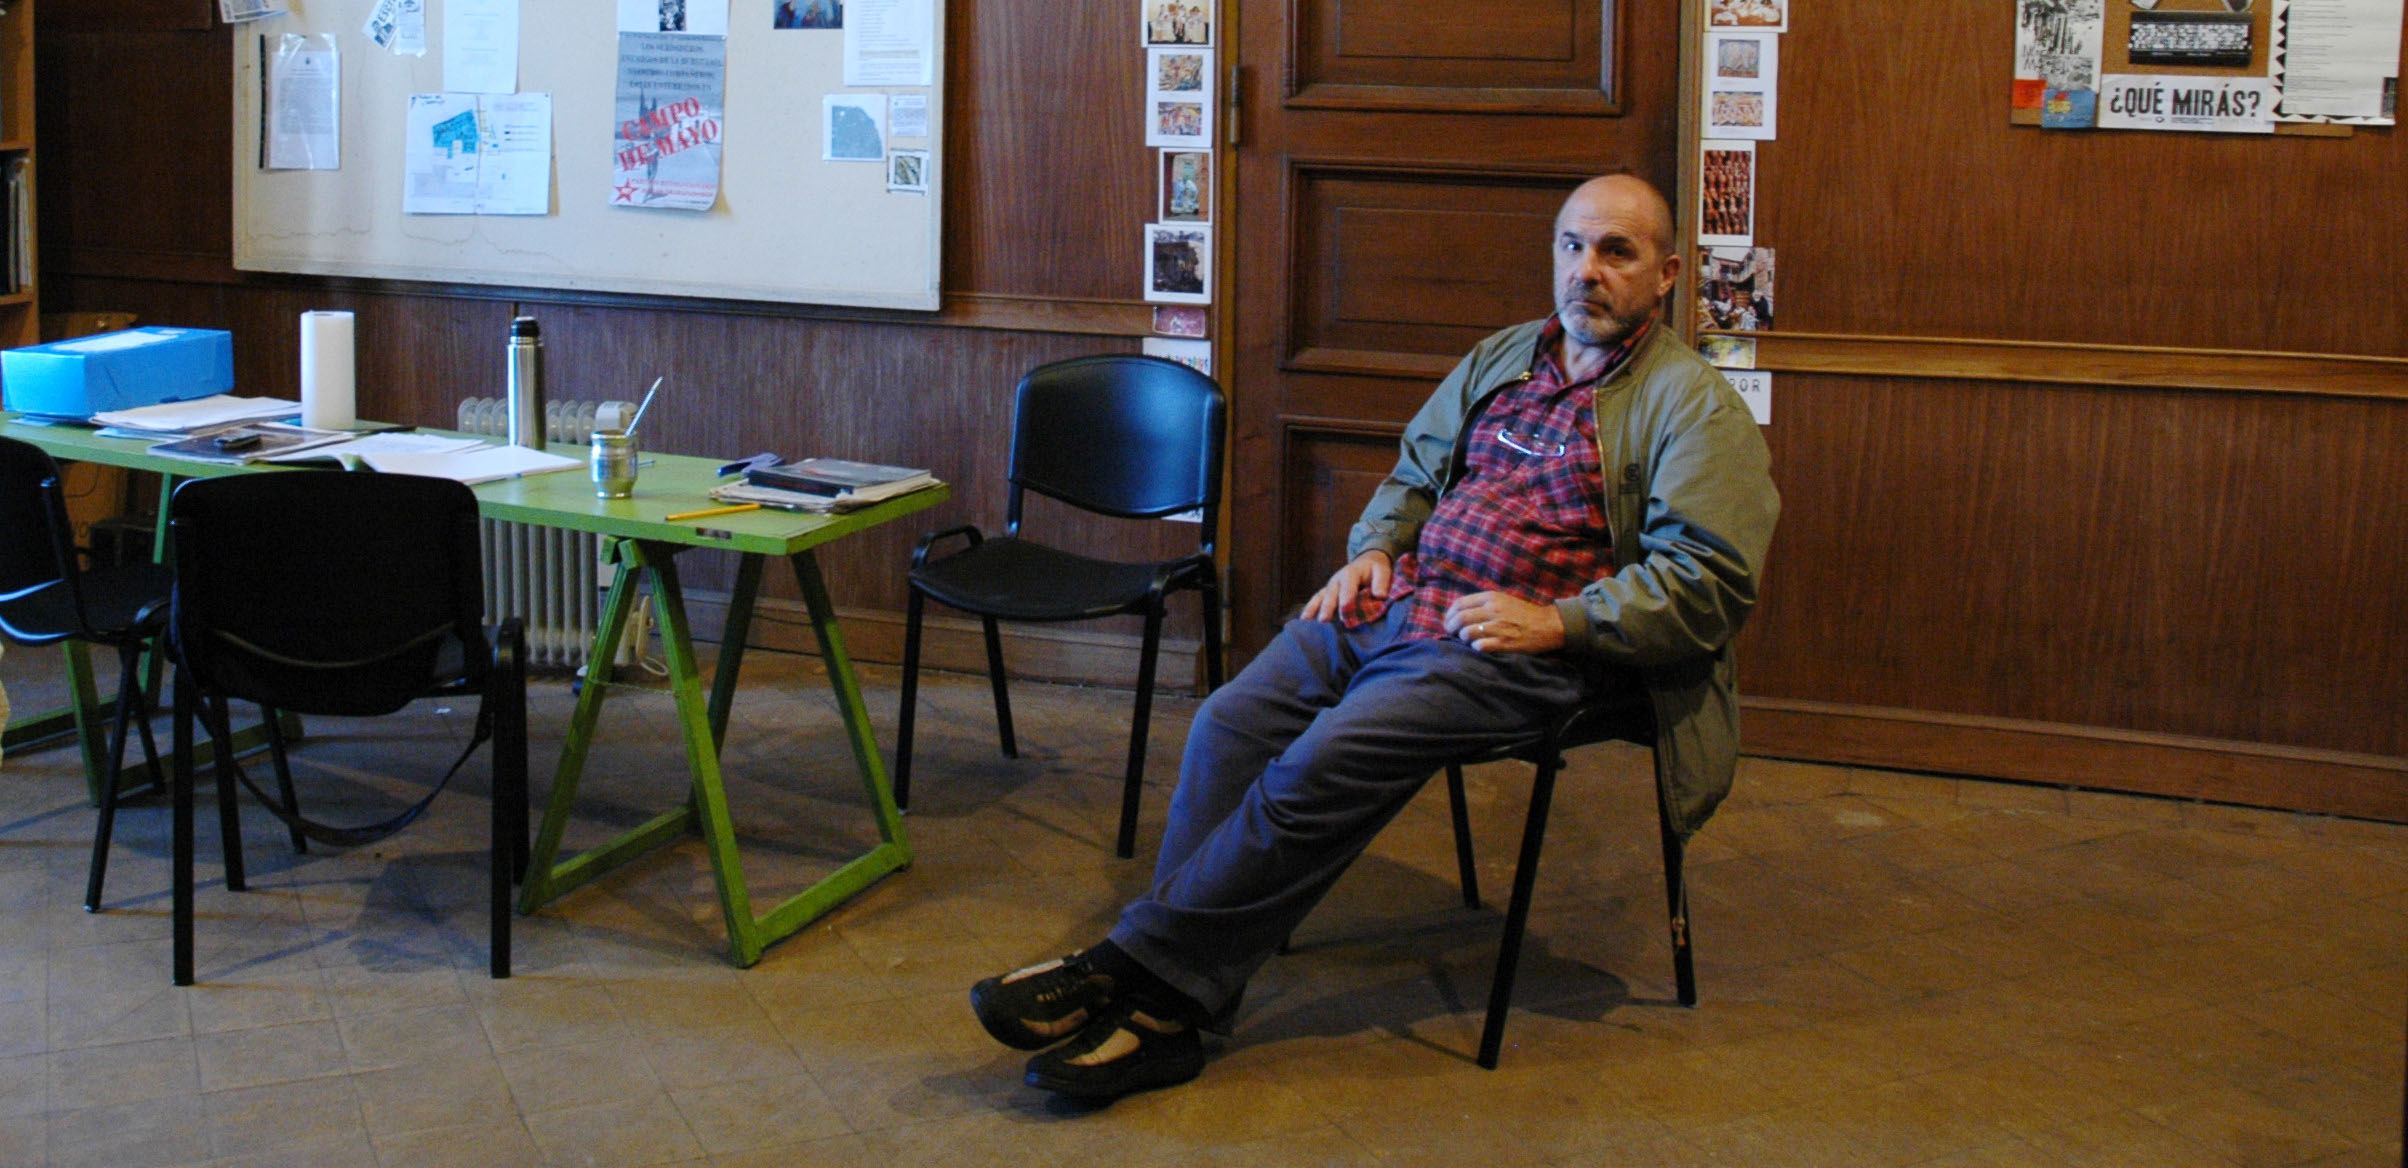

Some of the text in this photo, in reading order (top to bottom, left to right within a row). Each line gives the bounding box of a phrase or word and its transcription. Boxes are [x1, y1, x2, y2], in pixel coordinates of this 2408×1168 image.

[621, 96, 700, 141] CAMPO
[2110, 82, 2261, 118] ¿QUÉ MIRÁS?
[618, 119, 718, 172] DE MAYO
